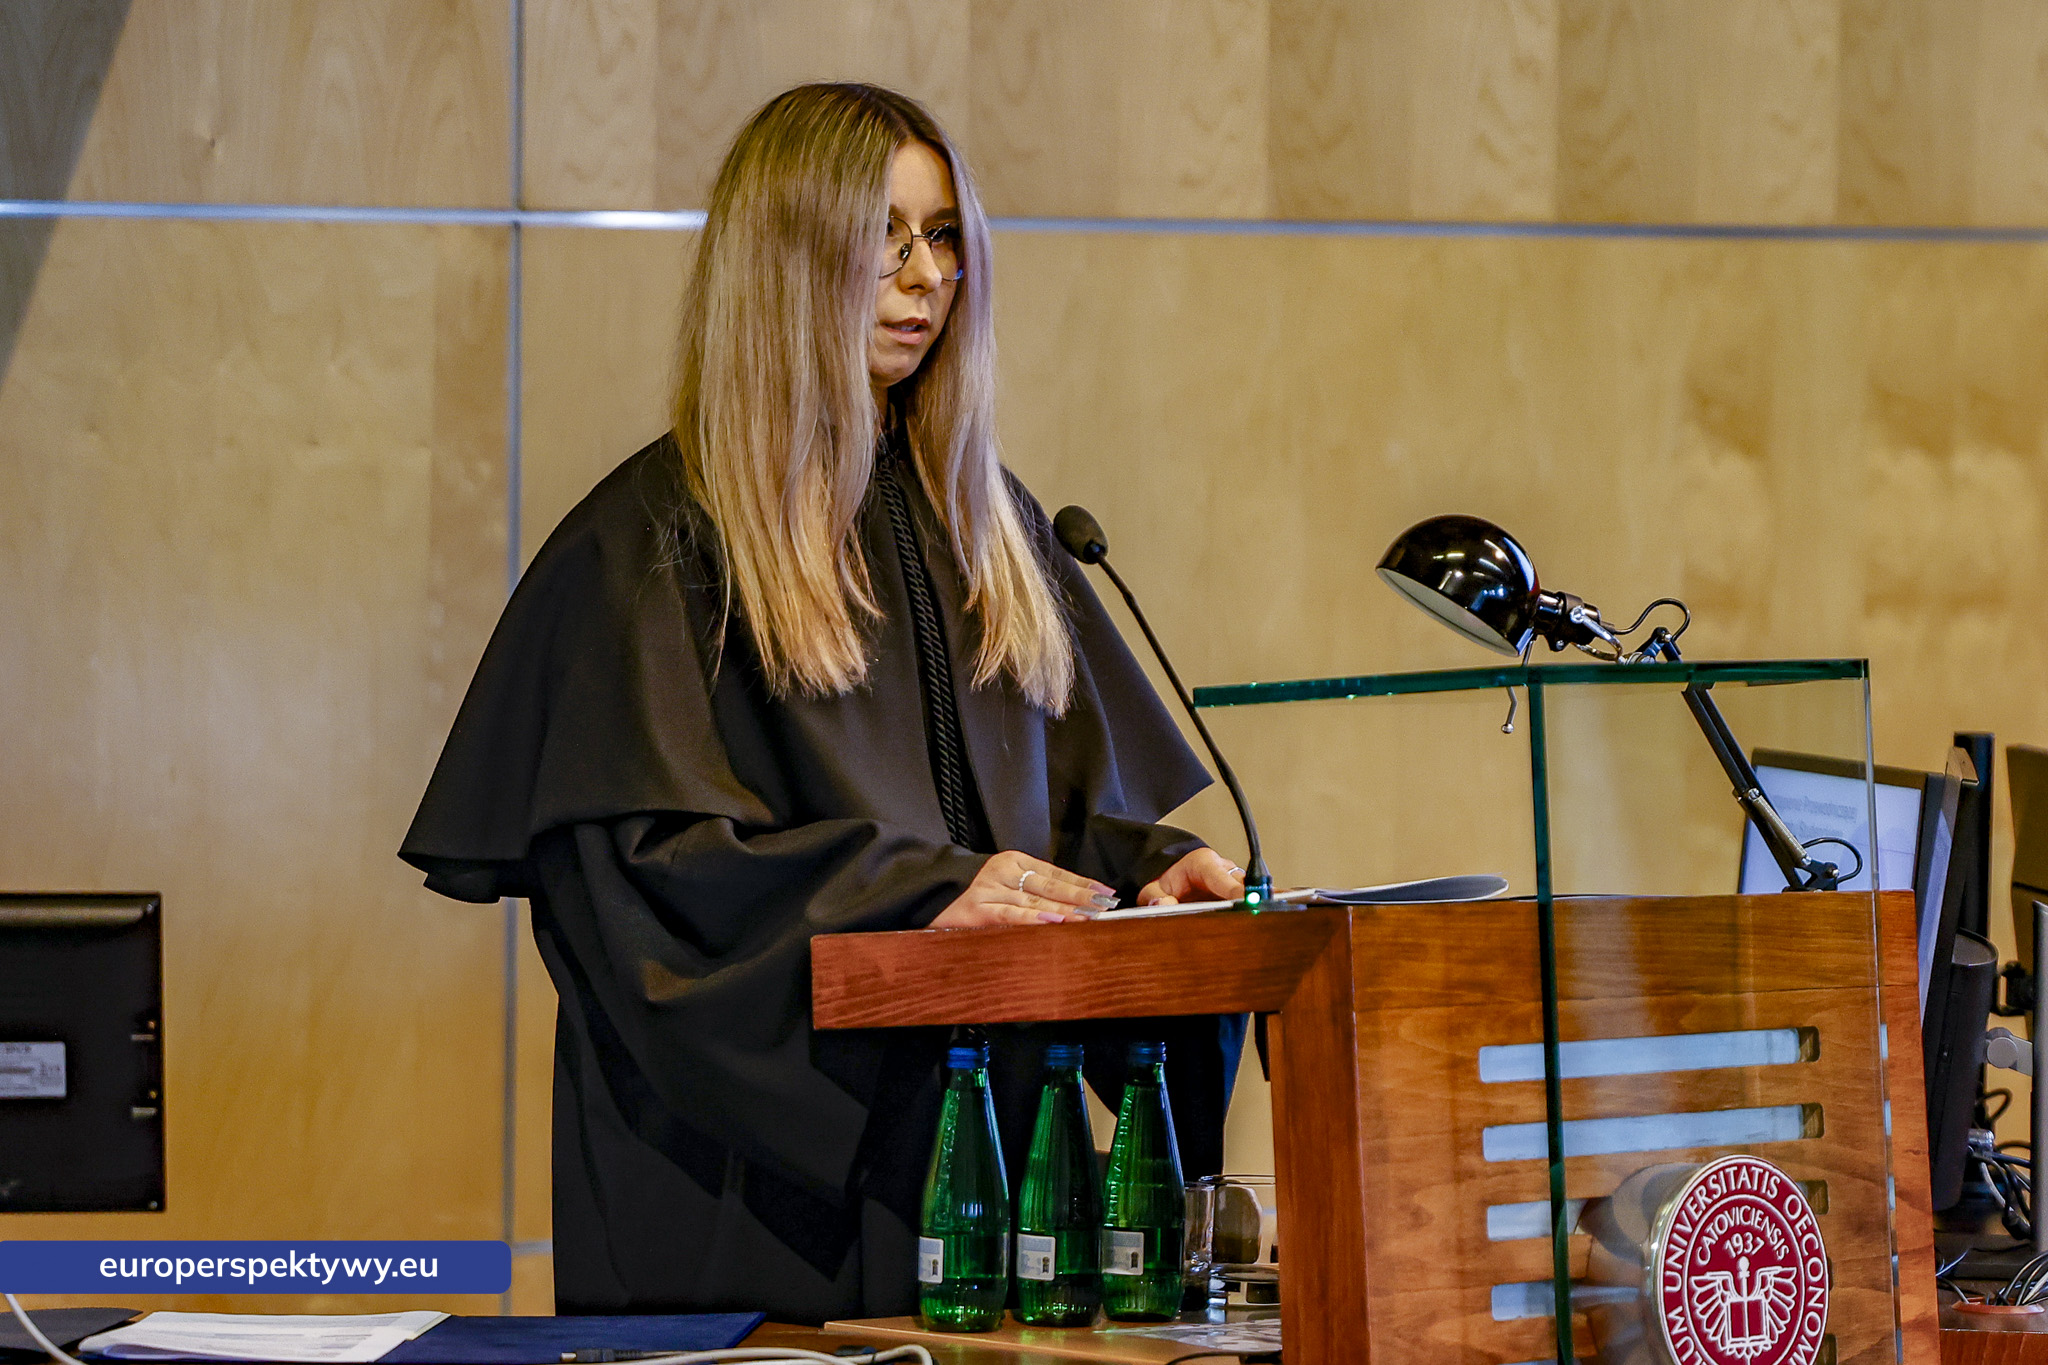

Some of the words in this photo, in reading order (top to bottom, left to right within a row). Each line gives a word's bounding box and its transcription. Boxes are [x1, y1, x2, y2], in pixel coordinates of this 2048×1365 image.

[1664, 1165, 1782, 1293] UNIVERSITATIS
[1696, 1205, 1790, 1266] CATOVICIENSIS
[1724, 1231, 1765, 1259] 1937
